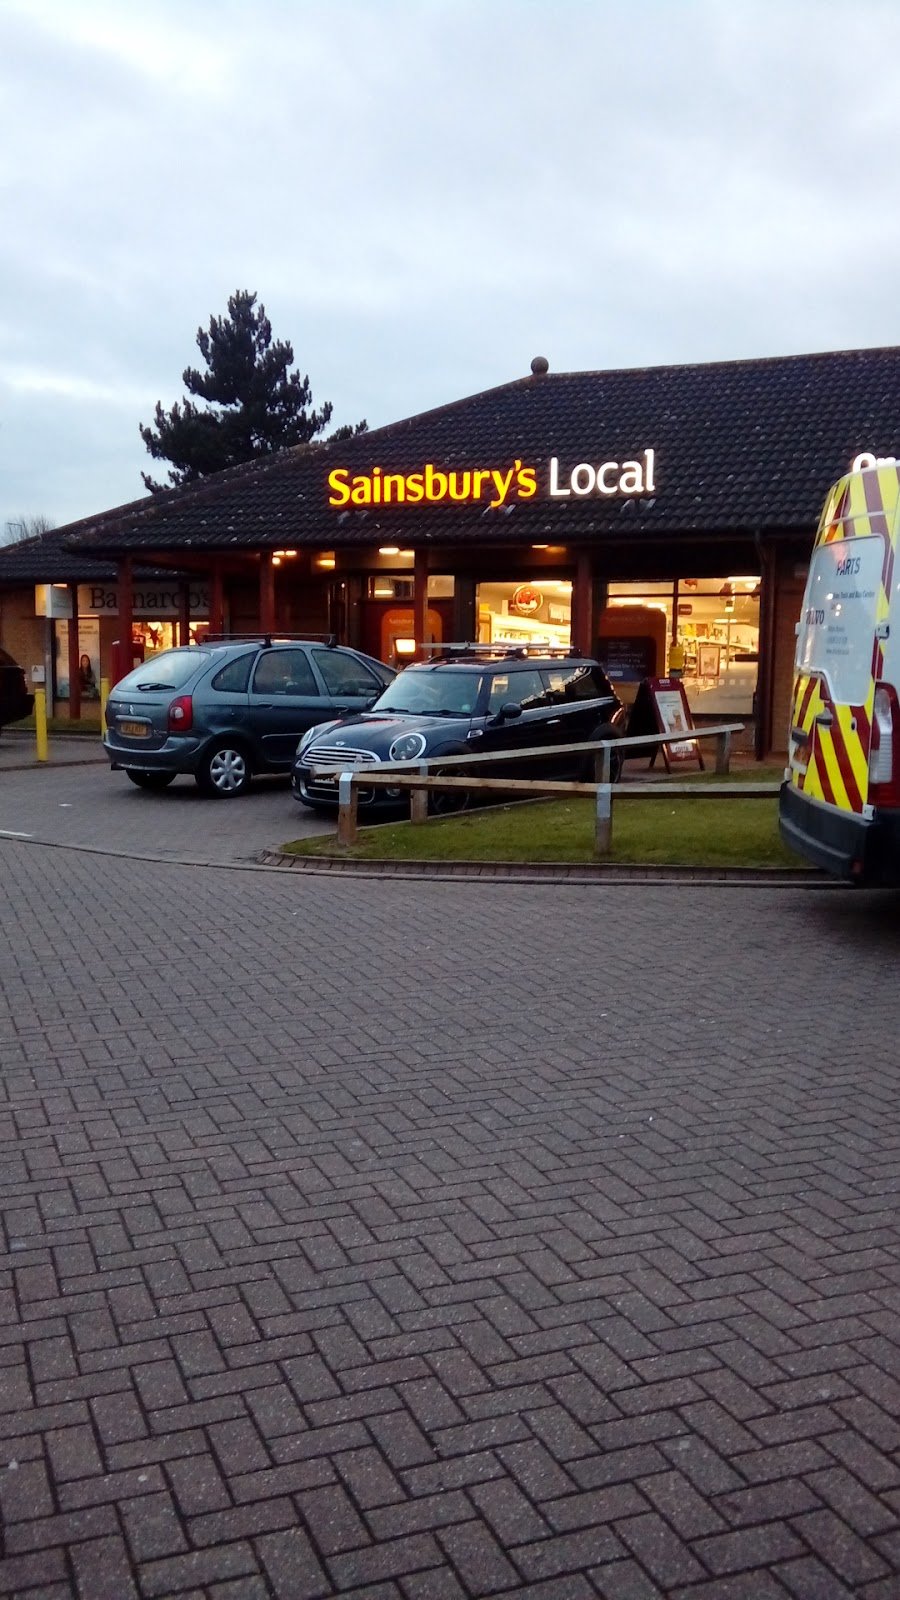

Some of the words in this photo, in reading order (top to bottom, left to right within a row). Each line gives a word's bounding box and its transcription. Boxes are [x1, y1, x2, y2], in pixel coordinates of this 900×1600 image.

[328, 459, 537, 508] Sainsbury's
[550, 448, 656, 497] Local
[836, 558, 860, 576] PARTS
